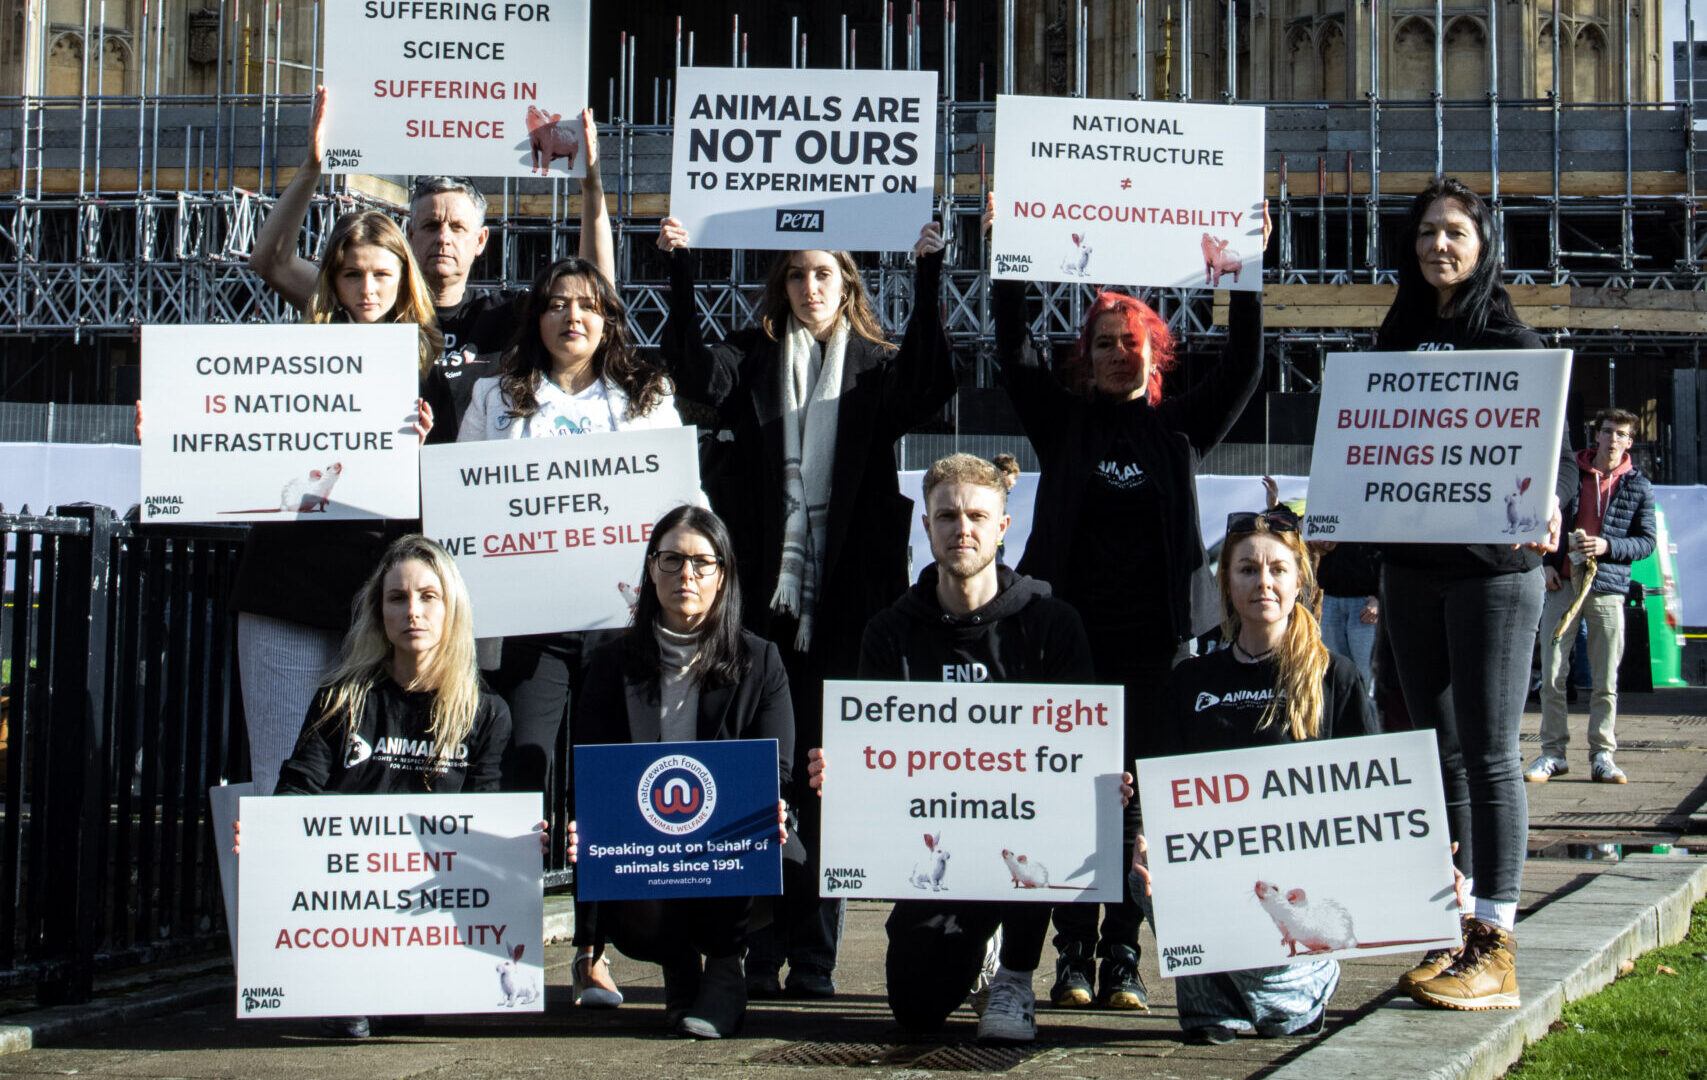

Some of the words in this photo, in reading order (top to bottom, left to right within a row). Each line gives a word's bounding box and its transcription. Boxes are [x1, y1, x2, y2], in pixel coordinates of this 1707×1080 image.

[365, 1, 497, 21] SUFFERING
[504, 3, 550, 22] FOR
[403, 41, 505, 60] SCIENCE
[374, 79, 506, 100] SUFFERING
[513, 82, 537, 100] IN
[689, 94, 842, 122] ANIMALS
[852, 97, 920, 123] ARE
[406, 119, 505, 139] SILENCE
[1073, 115, 1184, 136] NATIONAL
[325, 148, 363, 158] ANIMAL
[689, 128, 782, 163] NOT
[795, 130, 918, 166] OURS
[1031, 142, 1224, 166] INFRASTRUCTURE
[341, 159, 359, 168] AID
[687, 171, 718, 190] TO
[725, 172, 875, 192] EXPERIMENT
[882, 175, 917, 194] ON
[1014, 201, 1046, 218] NO
[1052, 203, 1243, 228] ACCOUNTABILITY
[995, 253, 1033, 264] ANIMAL
[1011, 264, 1030, 273] AID
[196, 355, 363, 375] COMPASSION
[1367, 371, 1519, 393] PROTECTING
[205, 395, 227, 413] IS
[234, 394, 362, 413] NATIONAL
[1337, 408, 1468, 429] BUILDINGS
[1475, 408, 1541, 428] OVER
[173, 432, 393, 452] INFRASTRUCTURE
[1346, 445, 1434, 466] BEINGS
[1441, 445, 1463, 465] IS
[1470, 445, 1522, 466] NOT
[460, 463, 540, 487] WHILE
[546, 454, 660, 480] ANIMALS
[145, 496, 184, 505] ANIMAL
[1364, 482, 1492, 503] PROGRESS
[162, 506, 181, 515] AID
[509, 492, 609, 517] SUFFER,
[1306, 515, 1340, 524] ANIMAL
[1319, 525, 1336, 534] AID
[438, 536, 477, 557] WE
[483, 530, 558, 555] CAN'T
[565, 528, 597, 548] BE
[602, 523, 653, 545] SILE
[942, 663, 988, 682] END
[1222, 688, 1275, 702] ANIMAL
[840, 695, 957, 723] Defend
[968, 703, 1022, 724] our
[1032, 698, 1108, 733] right
[374, 736, 437, 757] ANIMAL
[863, 745, 896, 769] to
[907, 747, 1026, 777] protest
[1035, 745, 1083, 773] for
[641, 757, 679, 804] naturewatch
[681, 758, 713, 802] foundation
[1171, 773, 1250, 809] END
[1261, 757, 1412, 800] ANIMAL
[909, 791, 1036, 820] animals
[303, 816, 342, 837] WE
[349, 815, 411, 836] WILL
[419, 815, 473, 835] NOT
[648, 813, 676, 833] ANIMAL
[677, 812, 708, 833] WELFARE
[1165, 808, 1430, 864] EXPERIMENTS
[589, 843, 655, 858] Speaking
[657, 844, 682, 854] out
[685, 844, 703, 853] on
[707, 839, 752, 852] behalf
[754, 839, 769, 851] of
[327, 854, 359, 873] BE
[367, 851, 457, 873] SILENT
[614, 860, 670, 874] animals
[673, 860, 709, 872] since
[713, 859, 744, 870] 1991.
[648, 876, 711, 886] naturewatch.org
[824, 868, 866, 878] ANIMAL
[842, 880, 862, 889] AID
[291, 889, 412, 911] ANIMALS
[419, 888, 490, 909] NEED
[275, 925, 507, 949] ACCOUNTABILITY
[1162, 943, 1205, 957] ANIMAL
[1181, 956, 1202, 967] AID
[242, 987, 285, 998] ANIMAL
[260, 999, 281, 1009] AID
